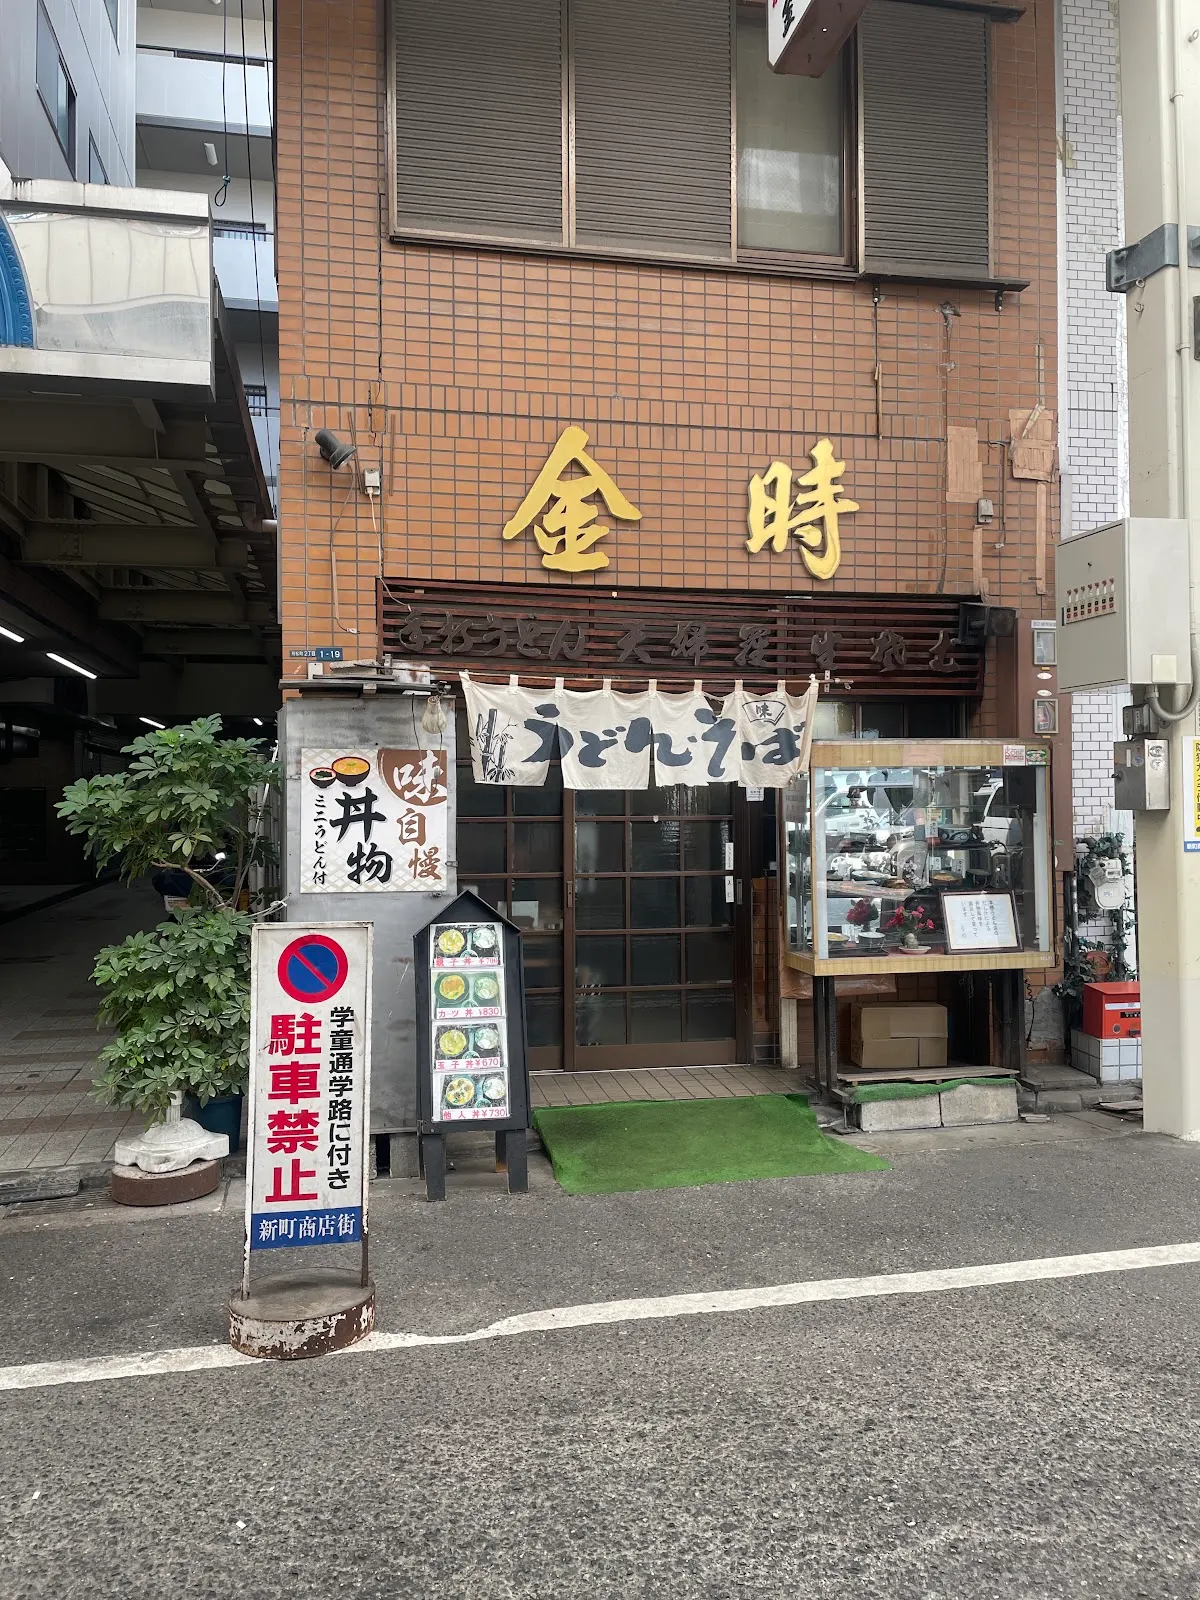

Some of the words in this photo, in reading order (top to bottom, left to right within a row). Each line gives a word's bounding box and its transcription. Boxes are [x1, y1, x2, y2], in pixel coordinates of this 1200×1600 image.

[503, 426, 860, 581] 金時
[320, 650, 341, 658] 1-19
[755, 702, 772, 719] 味
[329, 787, 394, 885] 丼物
[393, 750, 448, 880] 味自慢
[265, 1012, 322, 1203] 駐車禁止
[327, 1006, 354, 1191] 学童通学路に付き
[258, 1213, 356, 1242] 新町商店街
